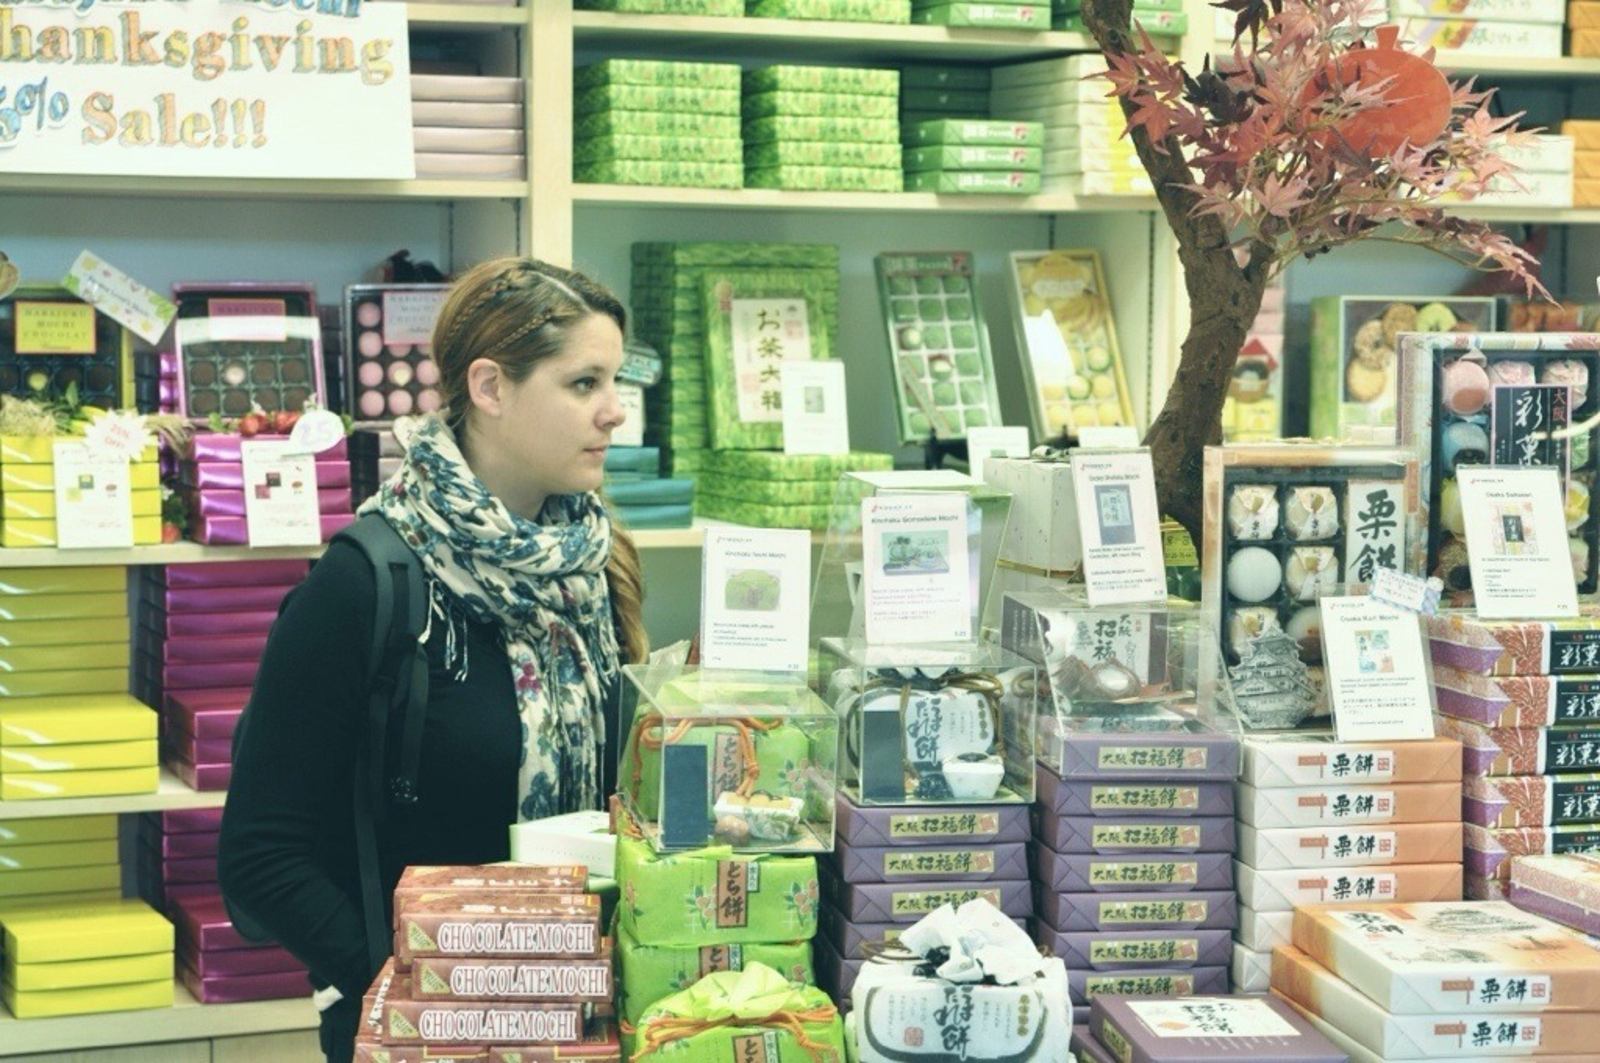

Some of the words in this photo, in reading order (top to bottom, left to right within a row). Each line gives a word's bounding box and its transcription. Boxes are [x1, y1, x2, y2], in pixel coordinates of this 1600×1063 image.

[0, 7, 393, 85] hanksgiving
[81, 92, 267, 148] Sale!!!
[757, 309, 782, 411] お茶大福
[1350, 489, 1397, 583] 栗餅
[1332, 753, 1374, 777] 栗餅
[1332, 794, 1374, 817] 栗餅
[1334, 834, 1376, 858] 栗餅
[1332, 876, 1375, 901] 栗餅
[438, 921, 536, 953] CHOCOLATE
[537, 922, 595, 953] MOCHI
[450, 965, 550, 996] CHOCOLATE
[551, 966, 608, 996] MOCHI
[1480, 978, 1527, 1004] 栗餅
[419, 1009, 520, 1040] CHOCOLATE
[520, 1009, 578, 1040] MOCHI
[1472, 1021, 1518, 1047] 栗餅
